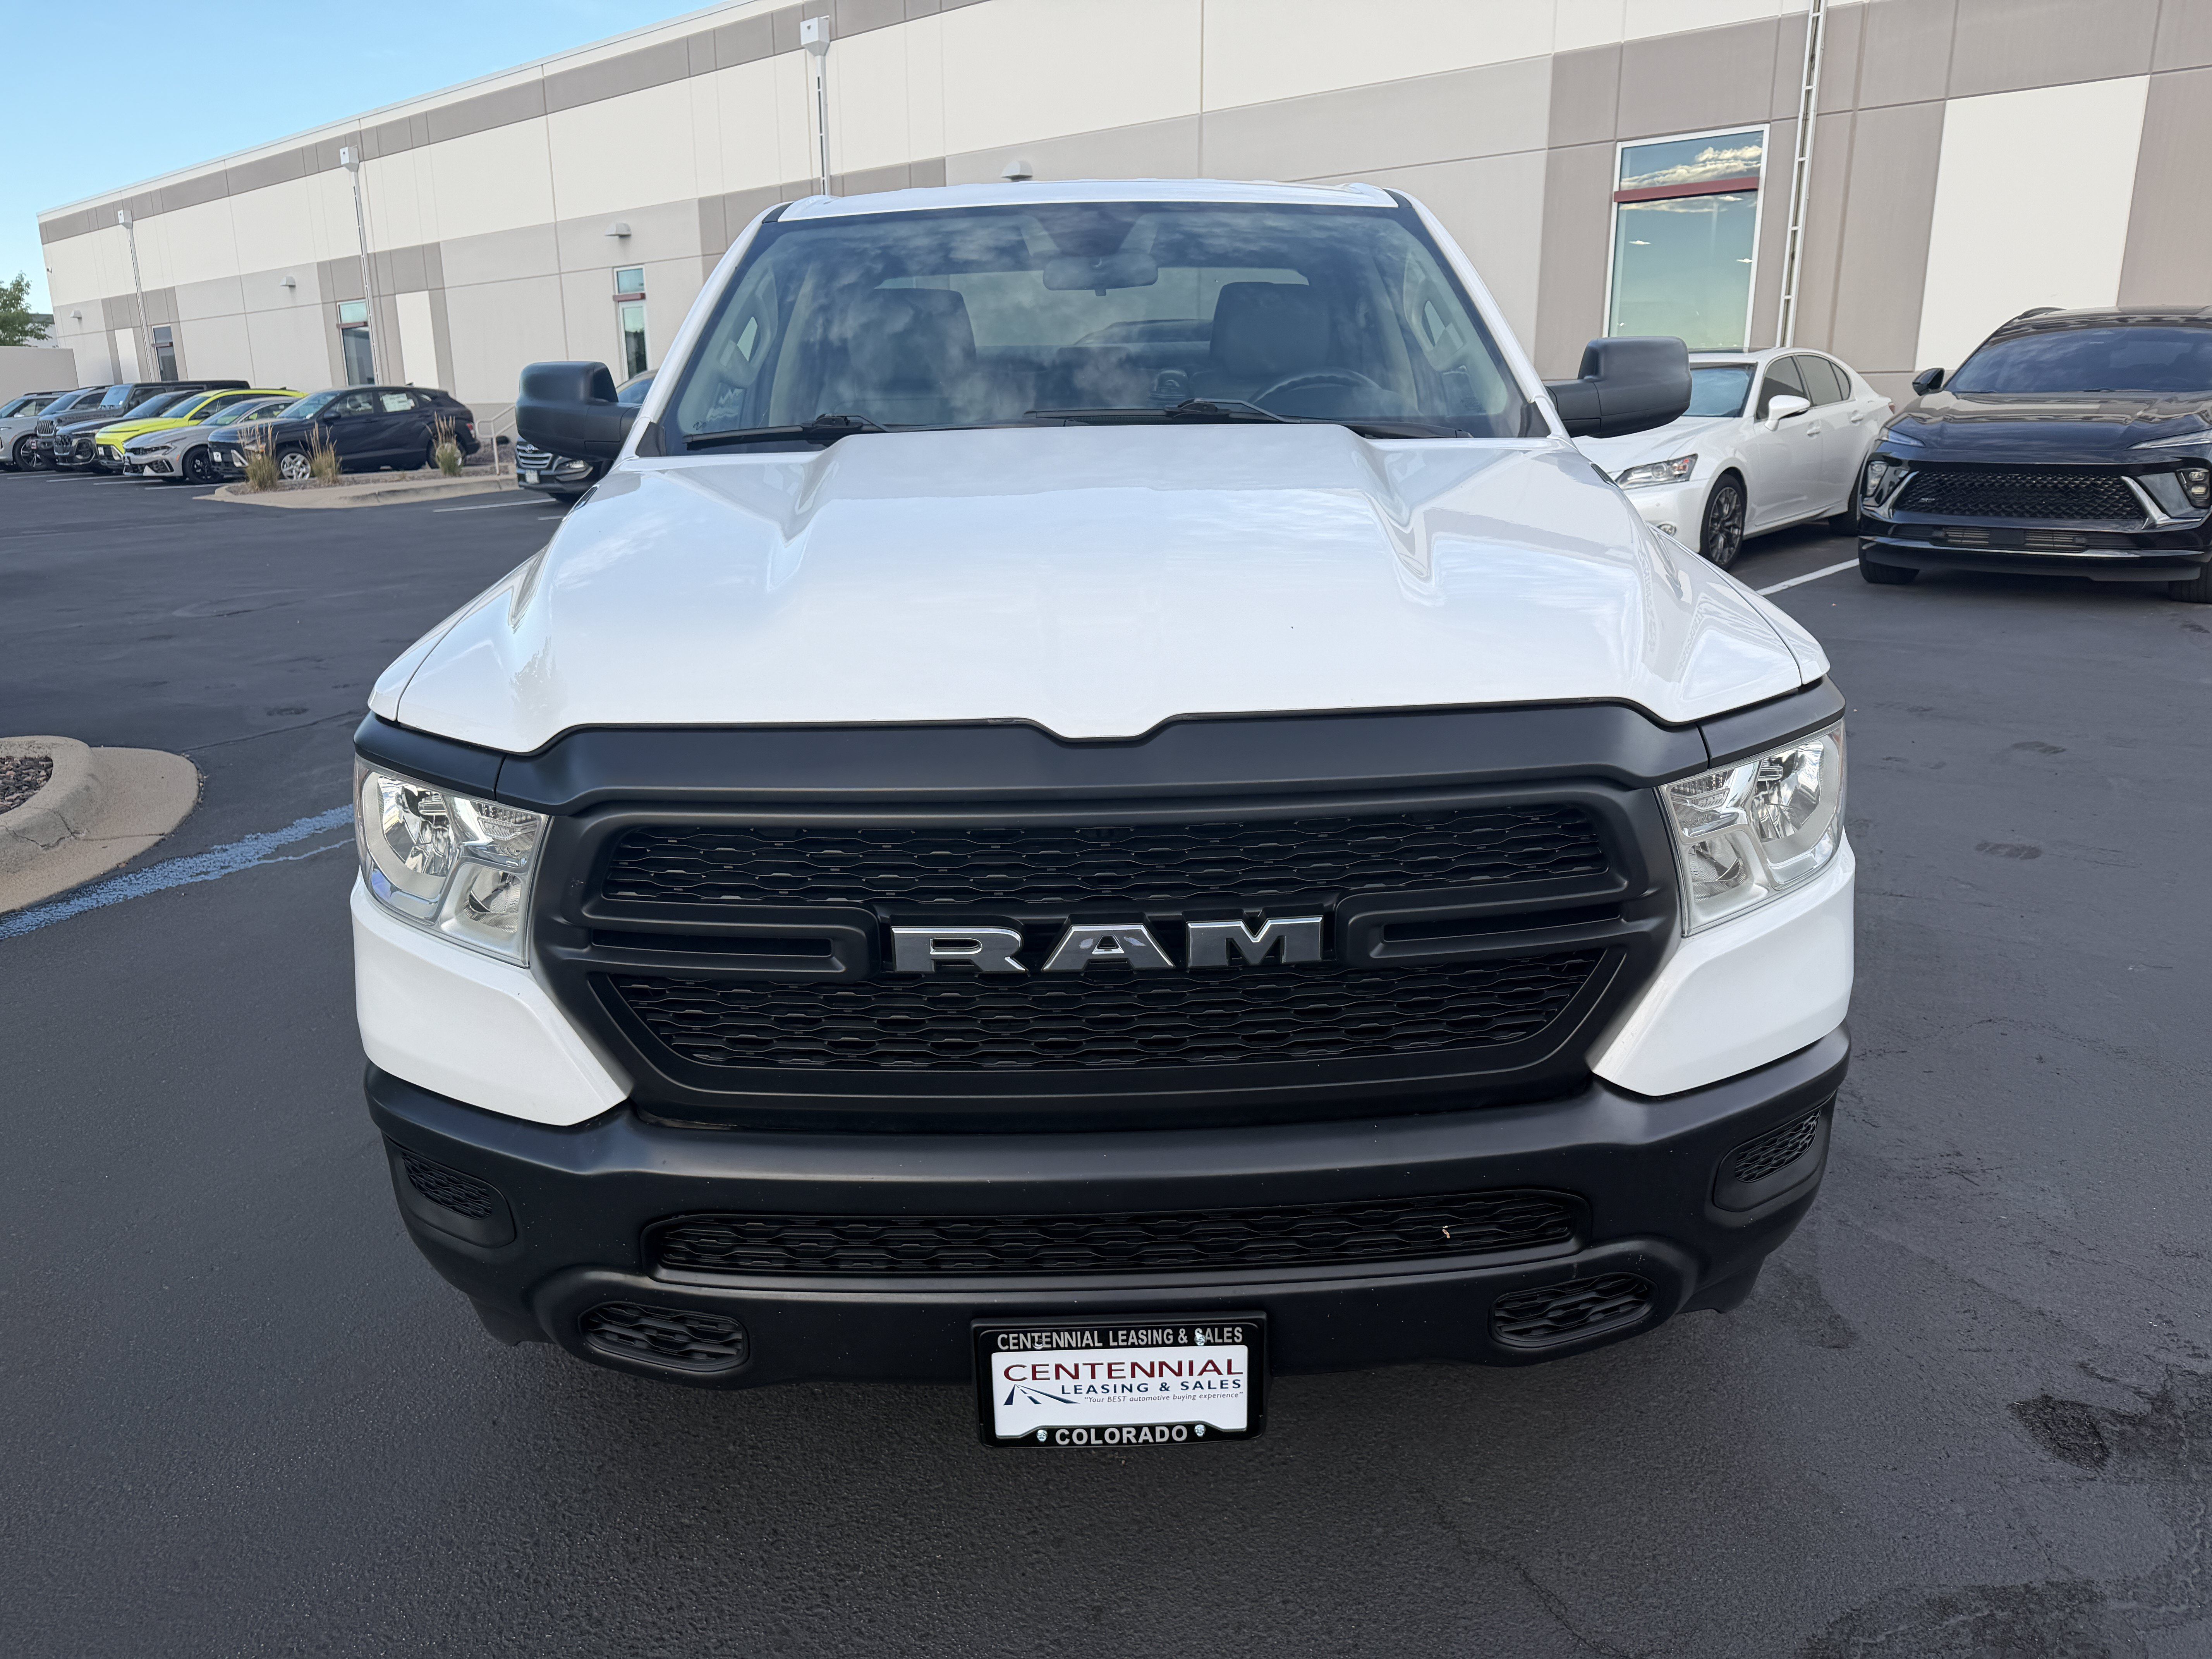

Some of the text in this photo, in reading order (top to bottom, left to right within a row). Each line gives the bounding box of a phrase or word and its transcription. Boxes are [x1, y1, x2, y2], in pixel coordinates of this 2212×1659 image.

[891, 916, 1323, 972] RAM
[997, 1331, 1103, 1350] CENTENNIAL
[1109, 1329, 1173, 1346] LEASING
[1178, 1328, 1188, 1344] &
[1004, 1358, 1243, 1381] CENTENNIAL
[1061, 1379, 1241, 1394] LEASING & SALES
[1199, 1391, 1243, 1400] experience”
[1055, 1425, 1187, 1445] COLORADO
